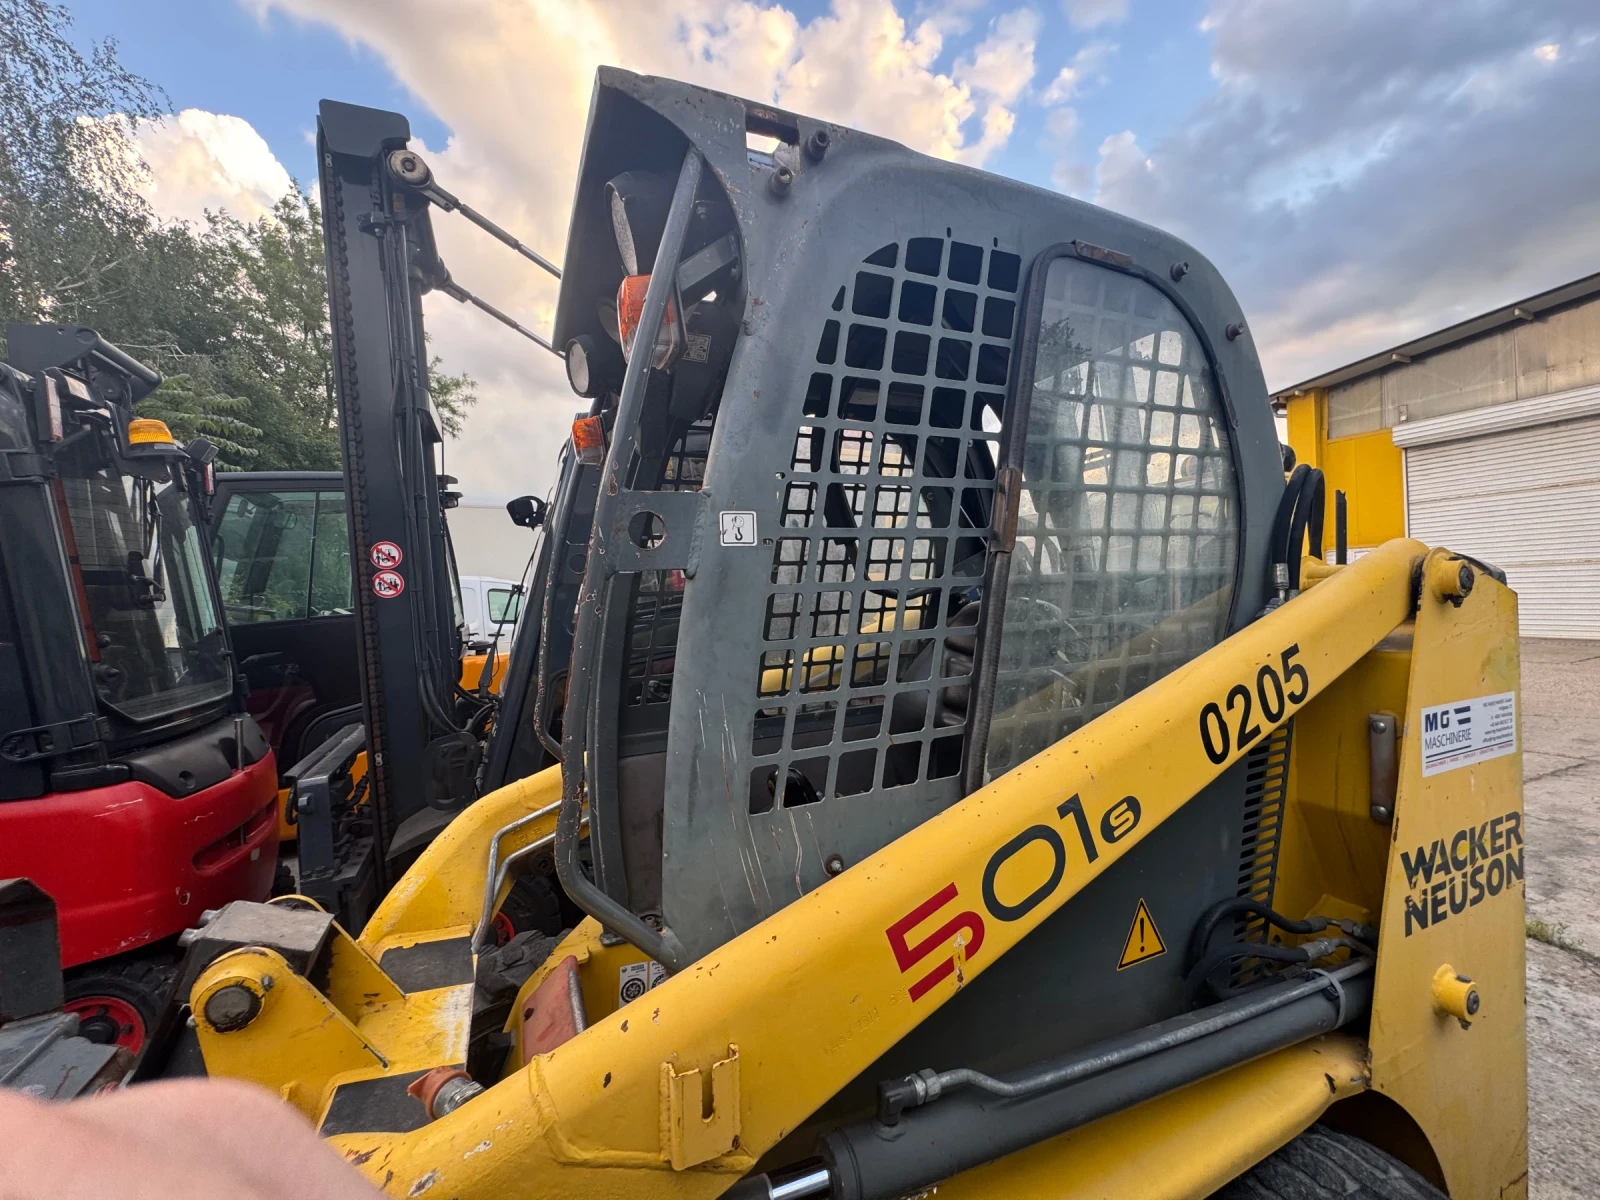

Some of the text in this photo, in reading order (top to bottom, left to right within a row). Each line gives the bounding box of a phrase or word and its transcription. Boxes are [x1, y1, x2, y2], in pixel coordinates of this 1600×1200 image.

[1199, 643, 1309, 765] 0205
[1425, 710, 1449, 733] MG
[1425, 728, 1472, 751] MASCHINERIE
[1400, 811, 1523, 890] WACKER
[1404, 847, 1525, 938] NEUSON
